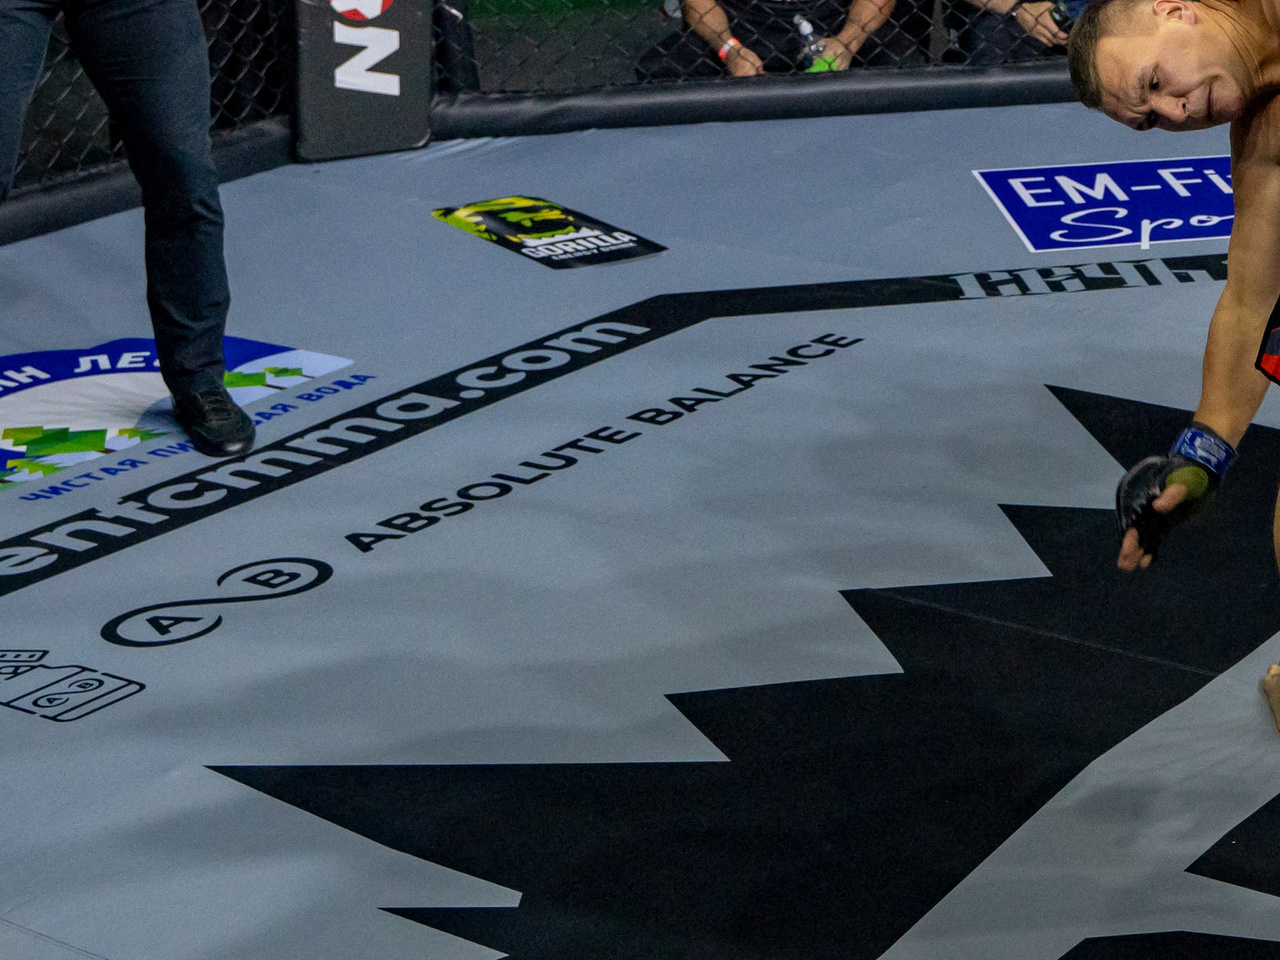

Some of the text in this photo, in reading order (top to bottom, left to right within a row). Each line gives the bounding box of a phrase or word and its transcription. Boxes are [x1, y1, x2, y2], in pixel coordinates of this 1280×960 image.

[1007, 167, 1234, 208] EM-Fi
[521, 231, 638, 259] GORILLA
[1050, 207, 1235, 250] Spo
[19, 374, 379, 503] ЧИСТАЯ ПИАЯ ВОДА
[344, 333, 866, 553] ABSOLUTE BALANCE
